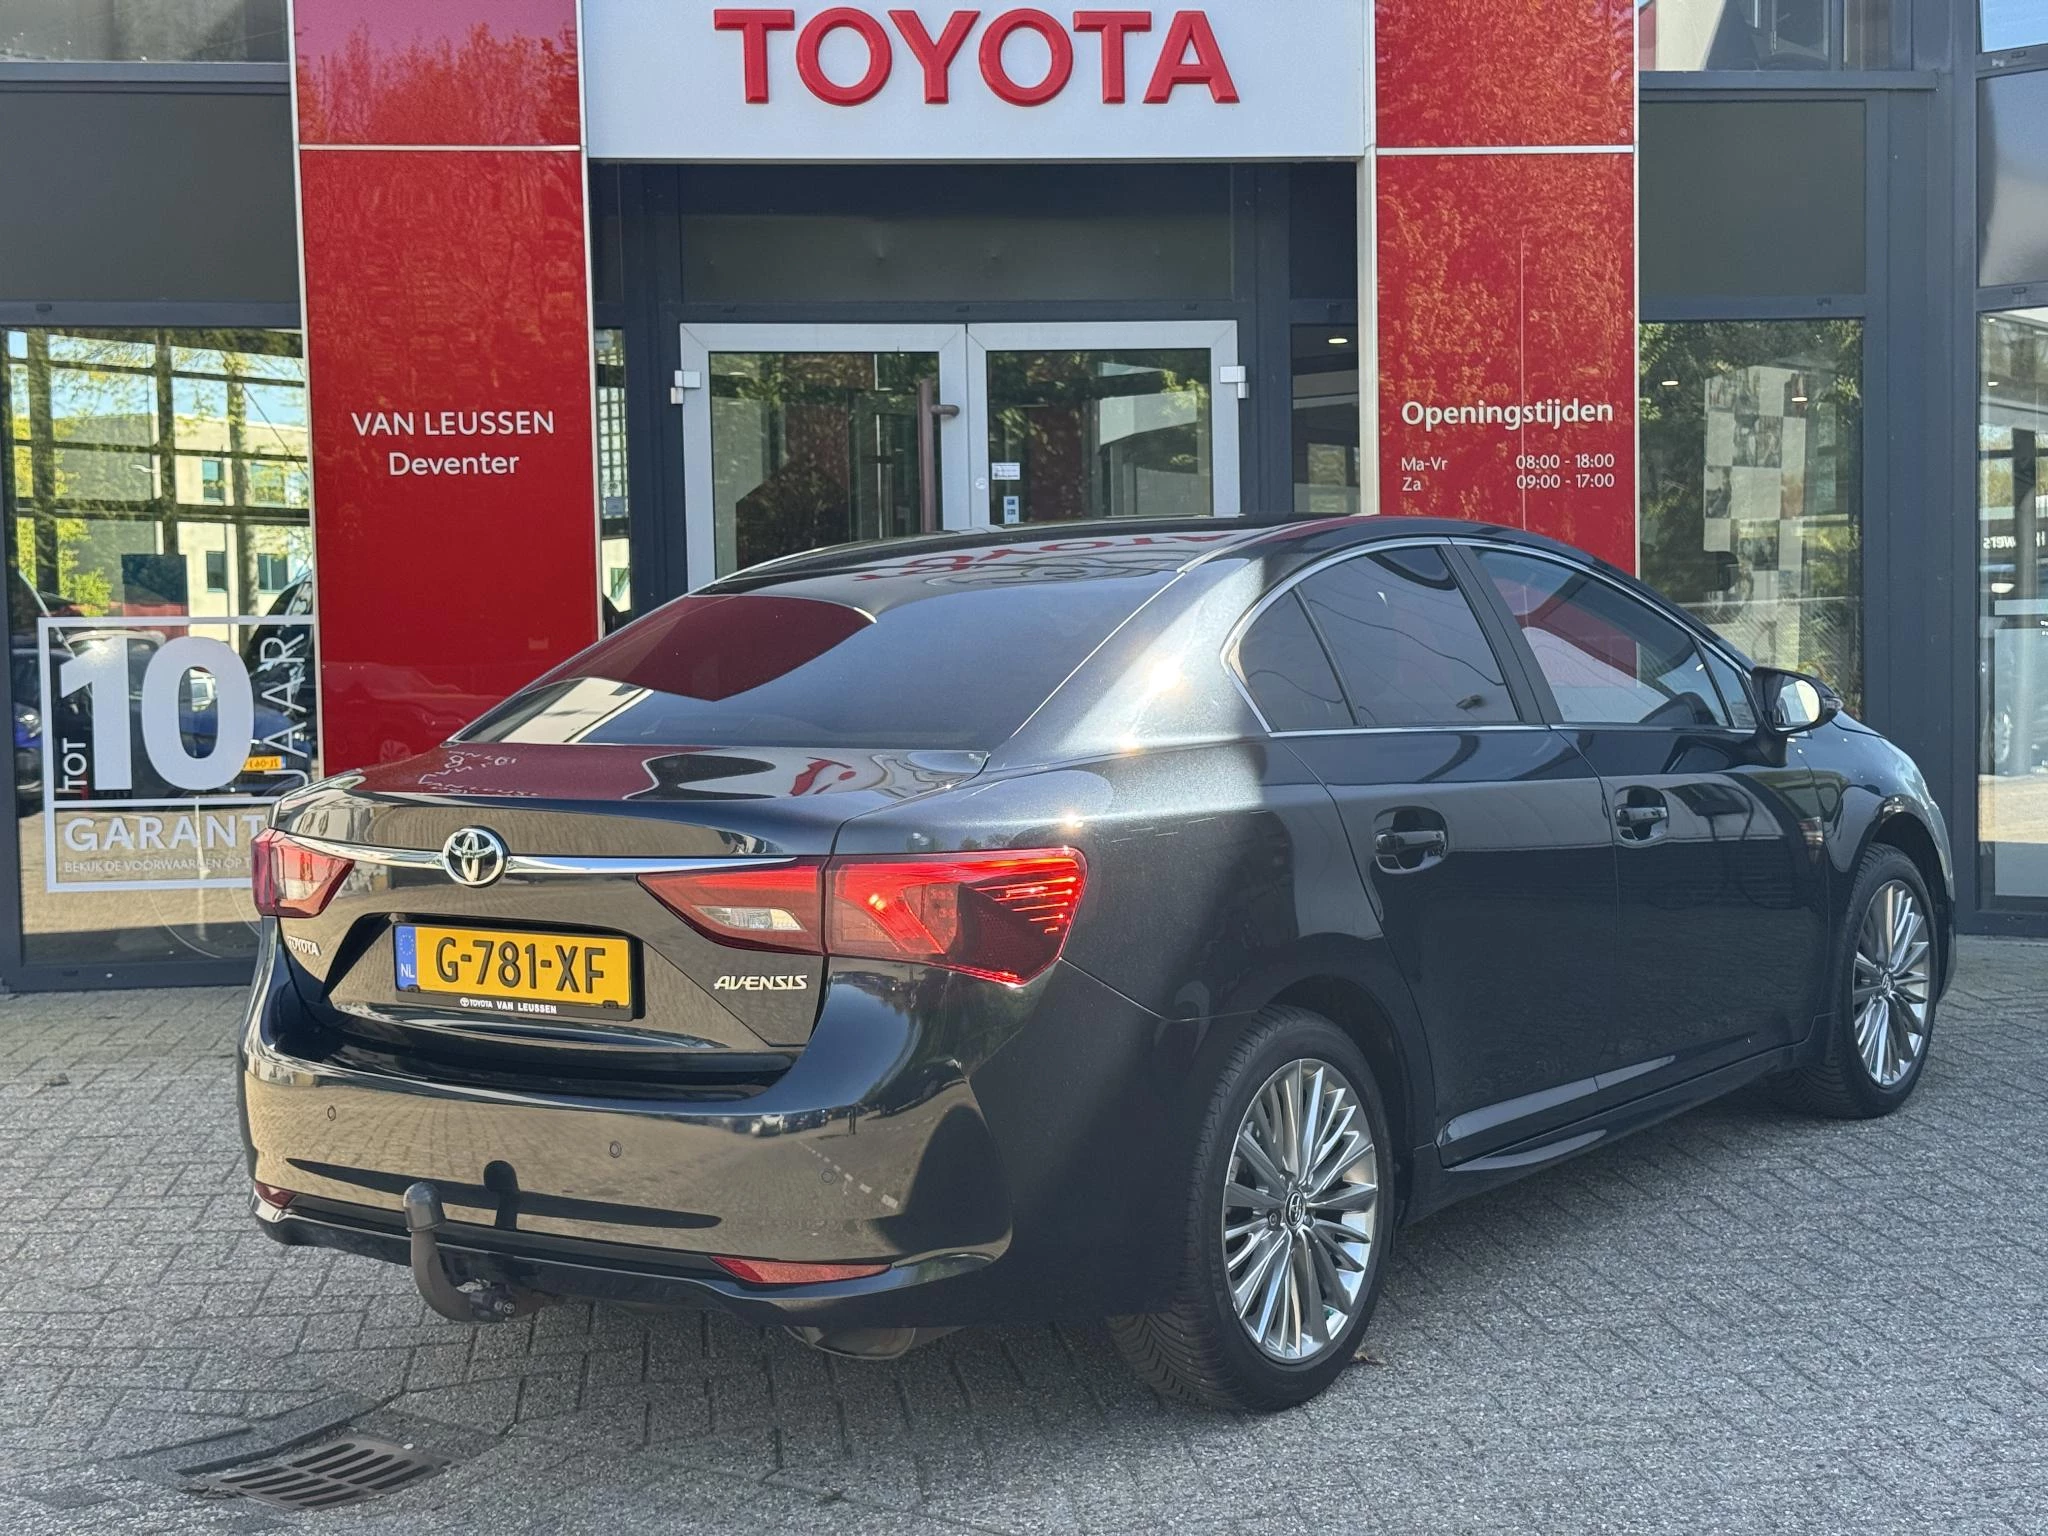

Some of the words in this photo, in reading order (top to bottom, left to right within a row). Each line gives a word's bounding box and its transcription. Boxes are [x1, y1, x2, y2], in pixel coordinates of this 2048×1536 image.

[713, 7, 1240, 107] TOYOTA
[351, 412, 415, 436] VAN
[424, 410, 555, 436] LEUSSEN
[1401, 398, 1614, 431] Openingstijden
[388, 452, 520, 476] Deventer
[1401, 457, 1448, 471] Ma-Vr
[1515, 454, 1560, 470] 08:00
[1575, 453, 1615, 468] 18:00
[1402, 477, 1422, 492] Za
[1516, 474, 1561, 489] 09:00
[1576, 473, 1615, 488] 17:00
[60, 636, 254, 791] 10
[259, 633, 310, 787] JAAR
[63, 738, 87, 790] TOT
[64, 815, 266, 852] GARANT
[105, 860, 122, 872] DE
[400, 963, 415, 978] NL
[435, 937, 606, 994] G-781-XF
[713, 974, 808, 991] AVENSIS
[470, 998, 493, 1008] TOYOTA
[496, 1000, 514, 1011] VAN
[517, 1002, 557, 1015] LEUSSEN
